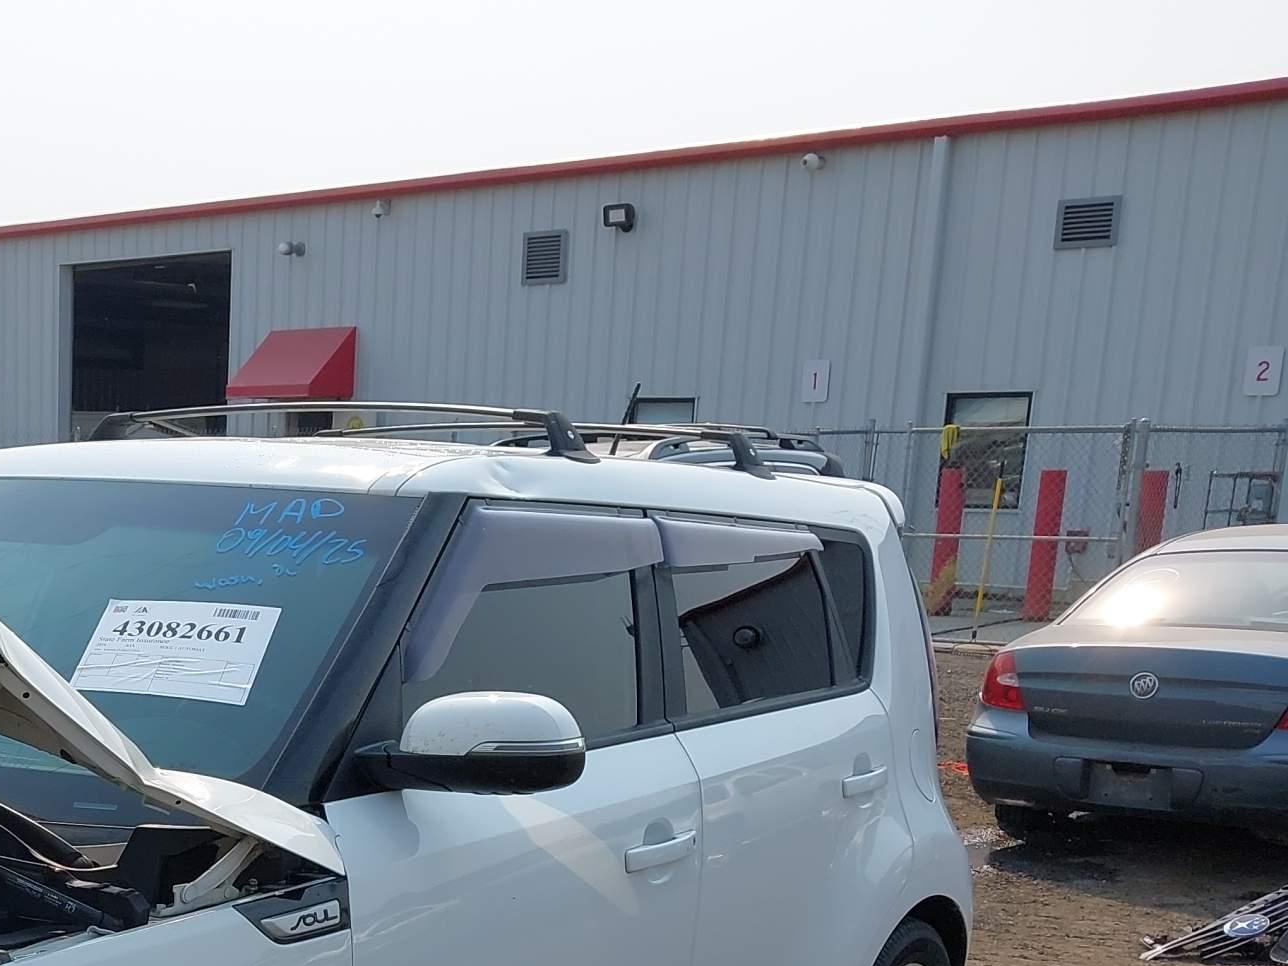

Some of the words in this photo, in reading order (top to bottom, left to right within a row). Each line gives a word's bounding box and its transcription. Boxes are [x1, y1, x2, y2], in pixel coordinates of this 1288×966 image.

[813, 371, 818, 390] 1
[1256, 360, 1270, 381] 2
[235, 498, 345, 526] MAD
[216, 527, 368, 566] 09/04/25
[112, 619, 248, 644] 43082661
